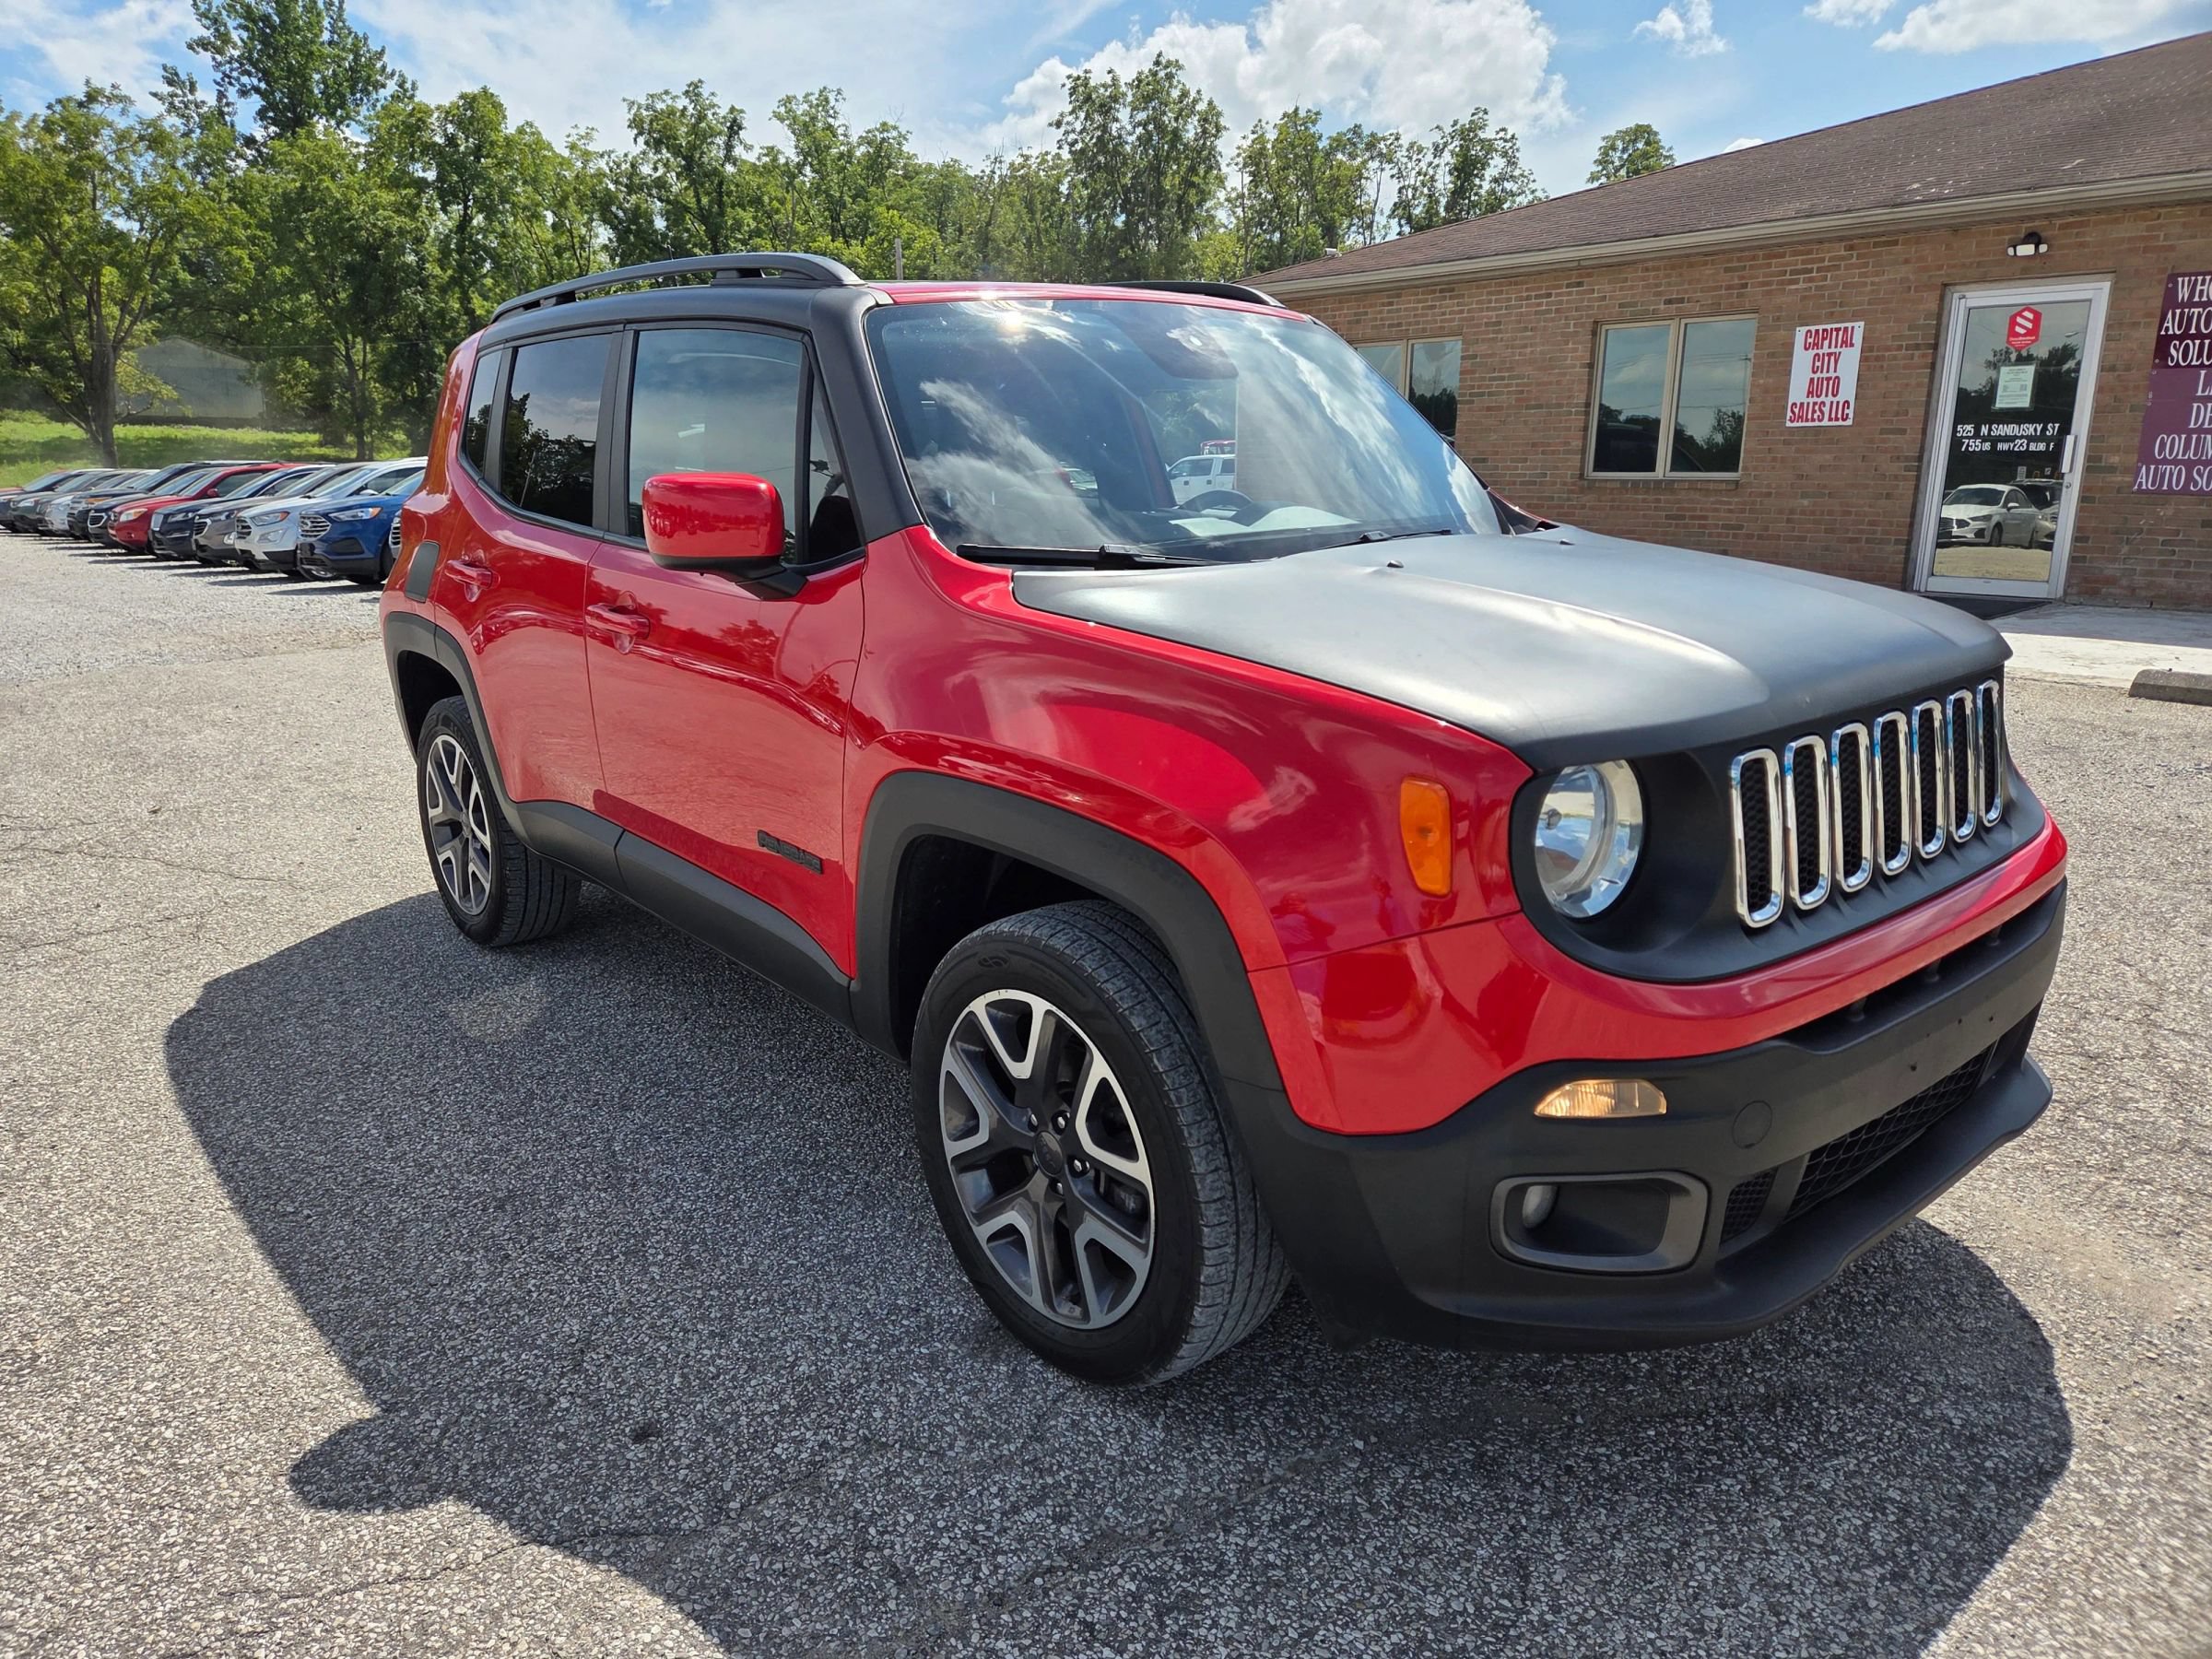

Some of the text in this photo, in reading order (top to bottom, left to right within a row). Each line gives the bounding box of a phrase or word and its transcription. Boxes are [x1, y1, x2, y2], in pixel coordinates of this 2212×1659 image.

[1803, 325, 1855, 351] CAPITAL
[1811, 351, 1841, 375] CITY
[1806, 375, 1841, 398] AUTO
[1789, 399, 1851, 423] SALES LLC
[1956, 423, 2060, 437] 525 N SANDUSKY ST
[2029, 442, 2046, 451] BLDG
[2049, 441, 2055, 452] F
[2134, 465, 2185, 490] AUTO
